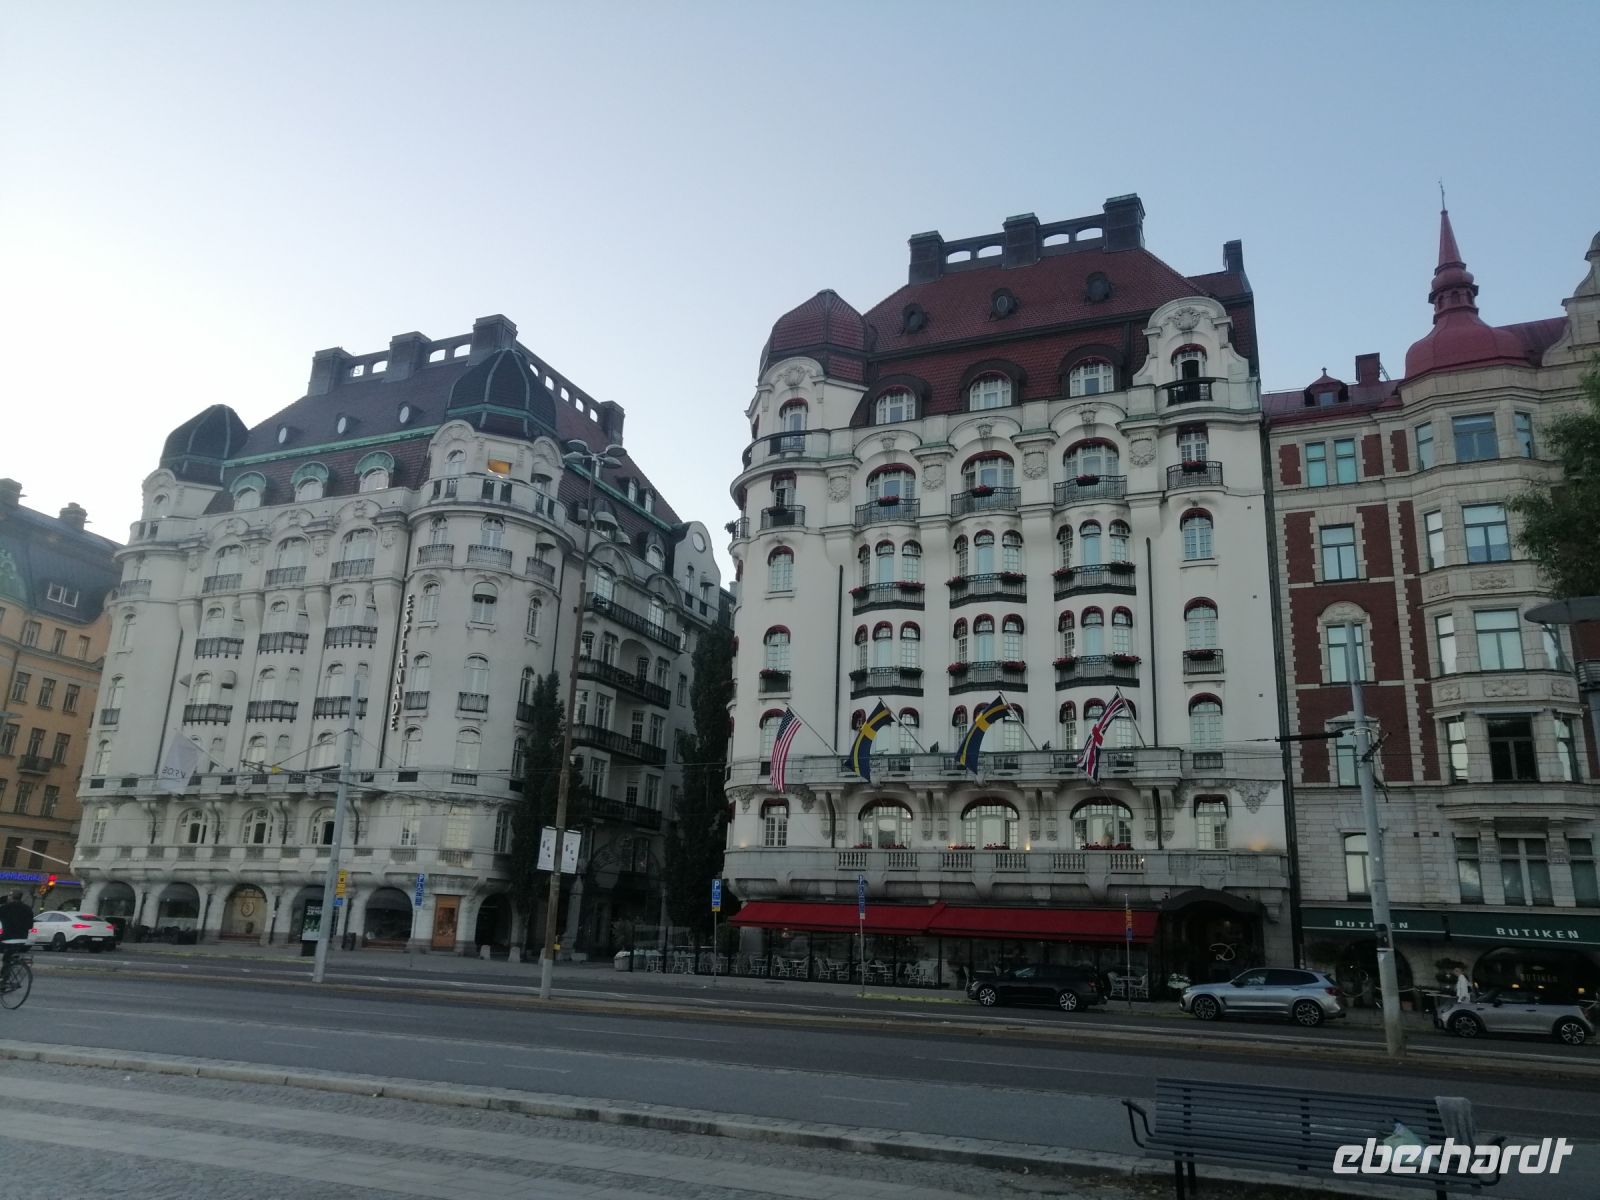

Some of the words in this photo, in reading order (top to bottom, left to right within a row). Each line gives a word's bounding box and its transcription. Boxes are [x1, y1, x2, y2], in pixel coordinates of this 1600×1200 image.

[390, 594, 415, 732] ESPLANADE
[1335, 919, 1408, 929] BUTIEN
[1496, 927, 1580, 939] BUTIKEN
